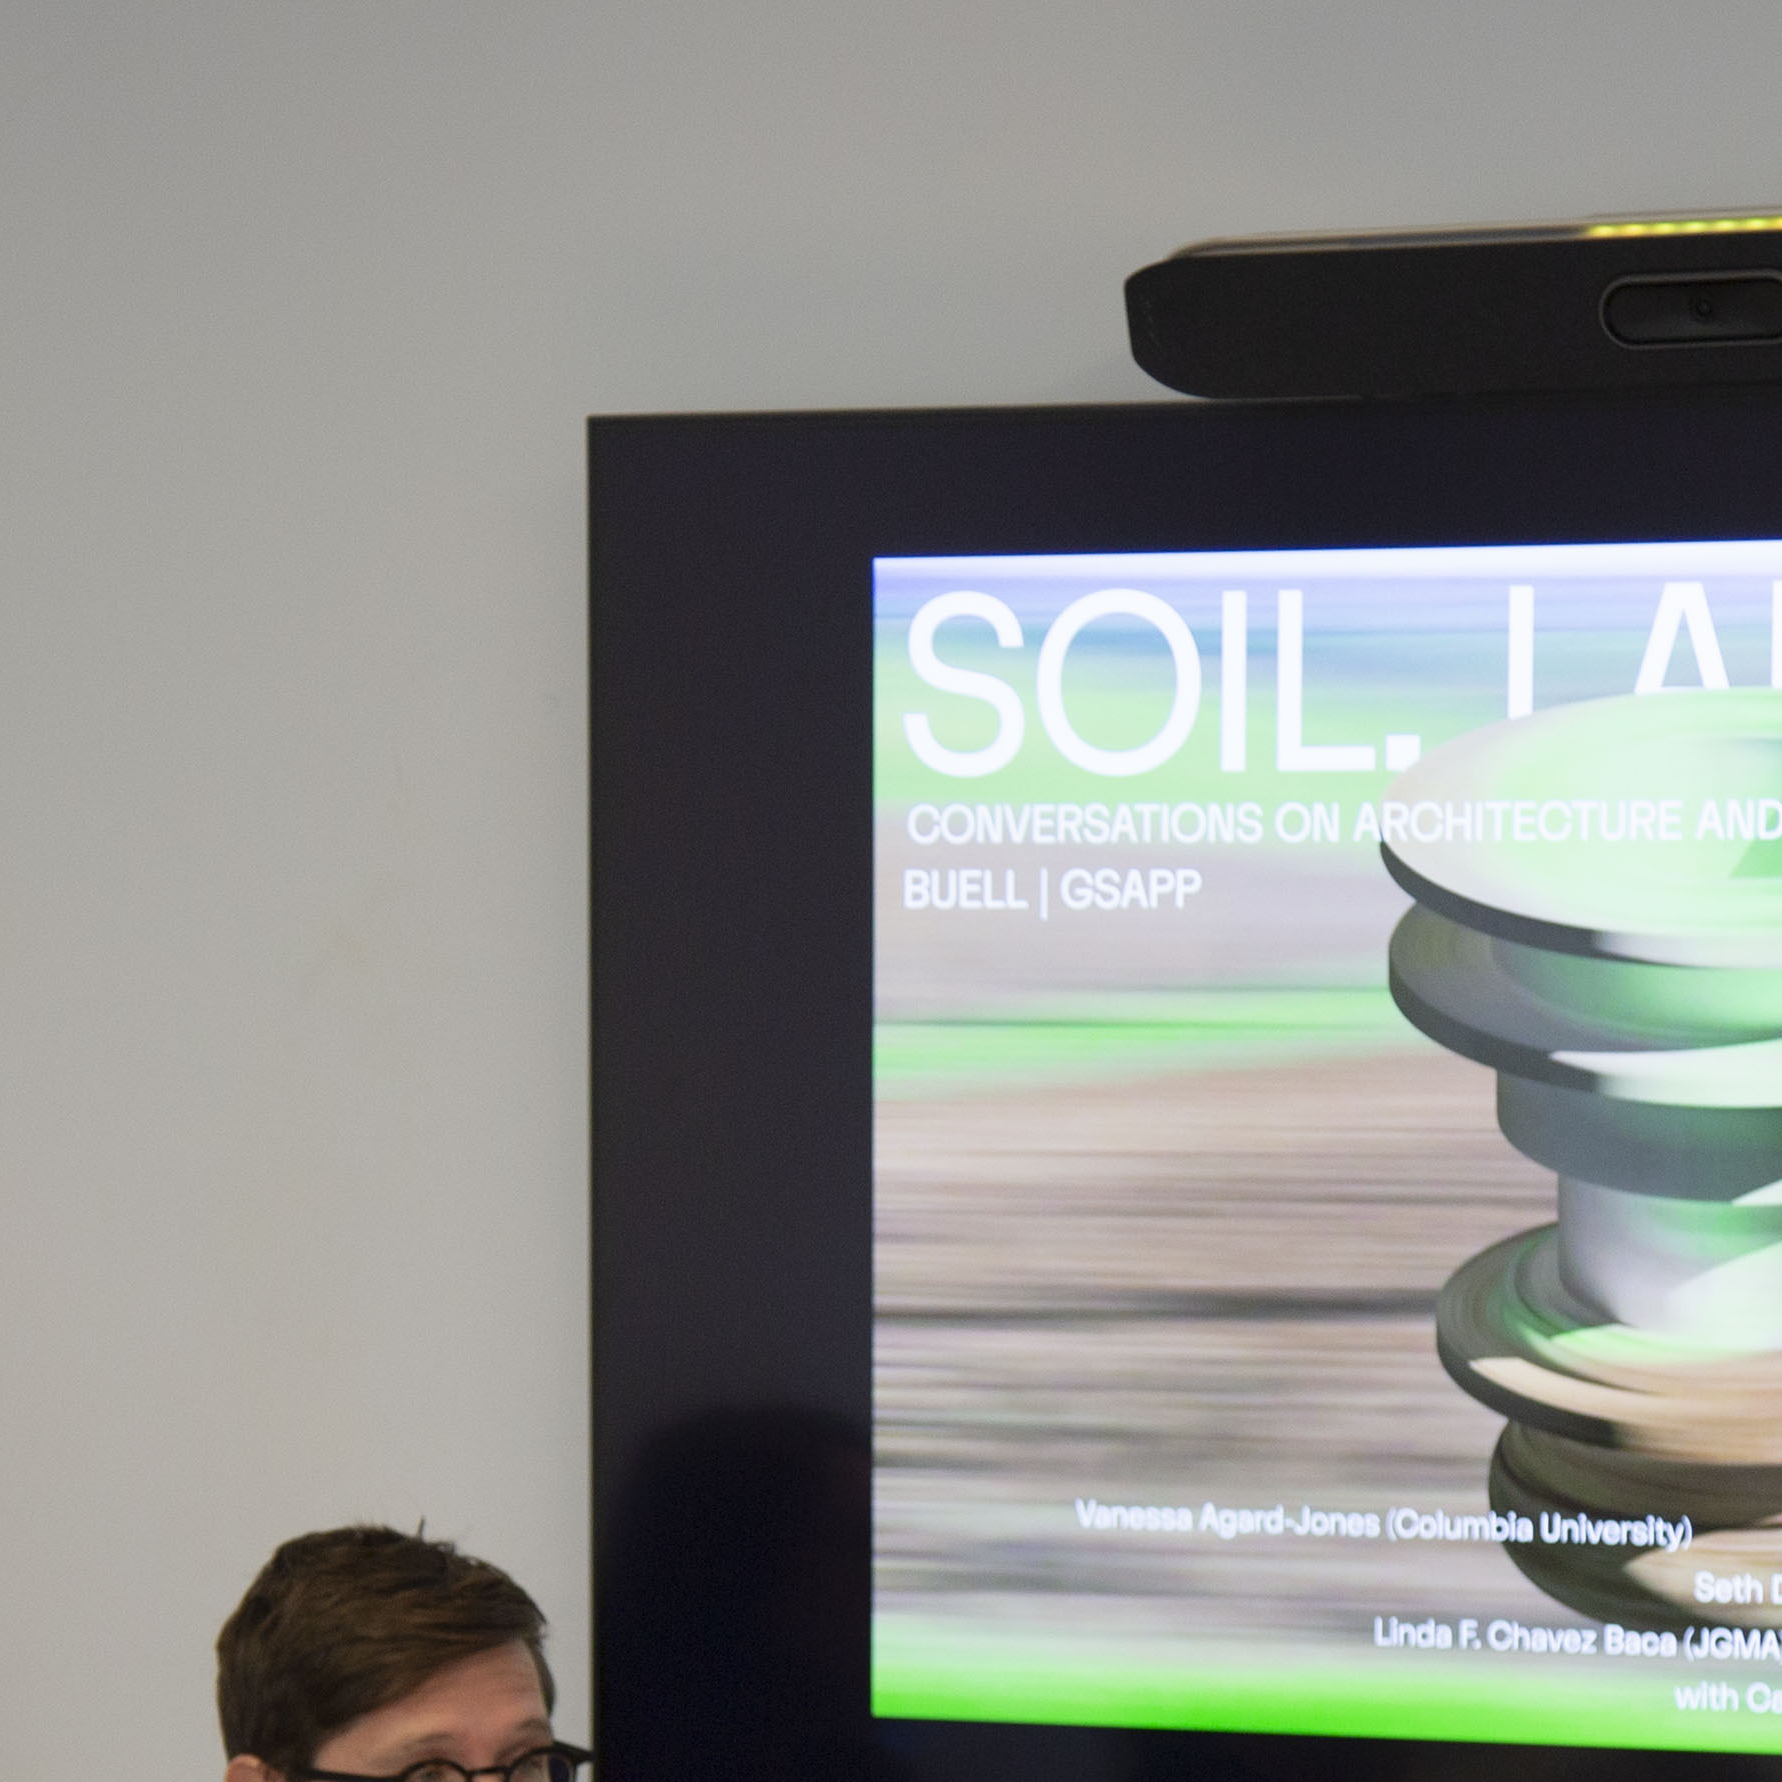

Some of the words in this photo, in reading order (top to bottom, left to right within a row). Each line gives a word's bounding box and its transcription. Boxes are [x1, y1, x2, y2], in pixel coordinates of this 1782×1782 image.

[907, 802, 1265, 845] CONVERSATIONS
[1274, 801, 1340, 843] ON
[1353, 800, 1684, 842] ARCHITECTURE
[903, 868, 1029, 909] BUELL
[1060, 868, 1202, 909] GSAPP
[1074, 1497, 1193, 1532] Vanessa
[1198, 1502, 1381, 1539] Agard-Jones
[1385, 1507, 1534, 1543] (Columbia
[1539, 1511, 1693, 1551] University)
[1694, 1570, 1764, 1604] Seth
[1373, 1616, 1453, 1649] Linda
[1459, 1618, 1481, 1649] F.
[1487, 1619, 1597, 1653] Chavez
[1603, 1623, 1677, 1657] Baca
[1674, 1681, 1739, 1711] with
